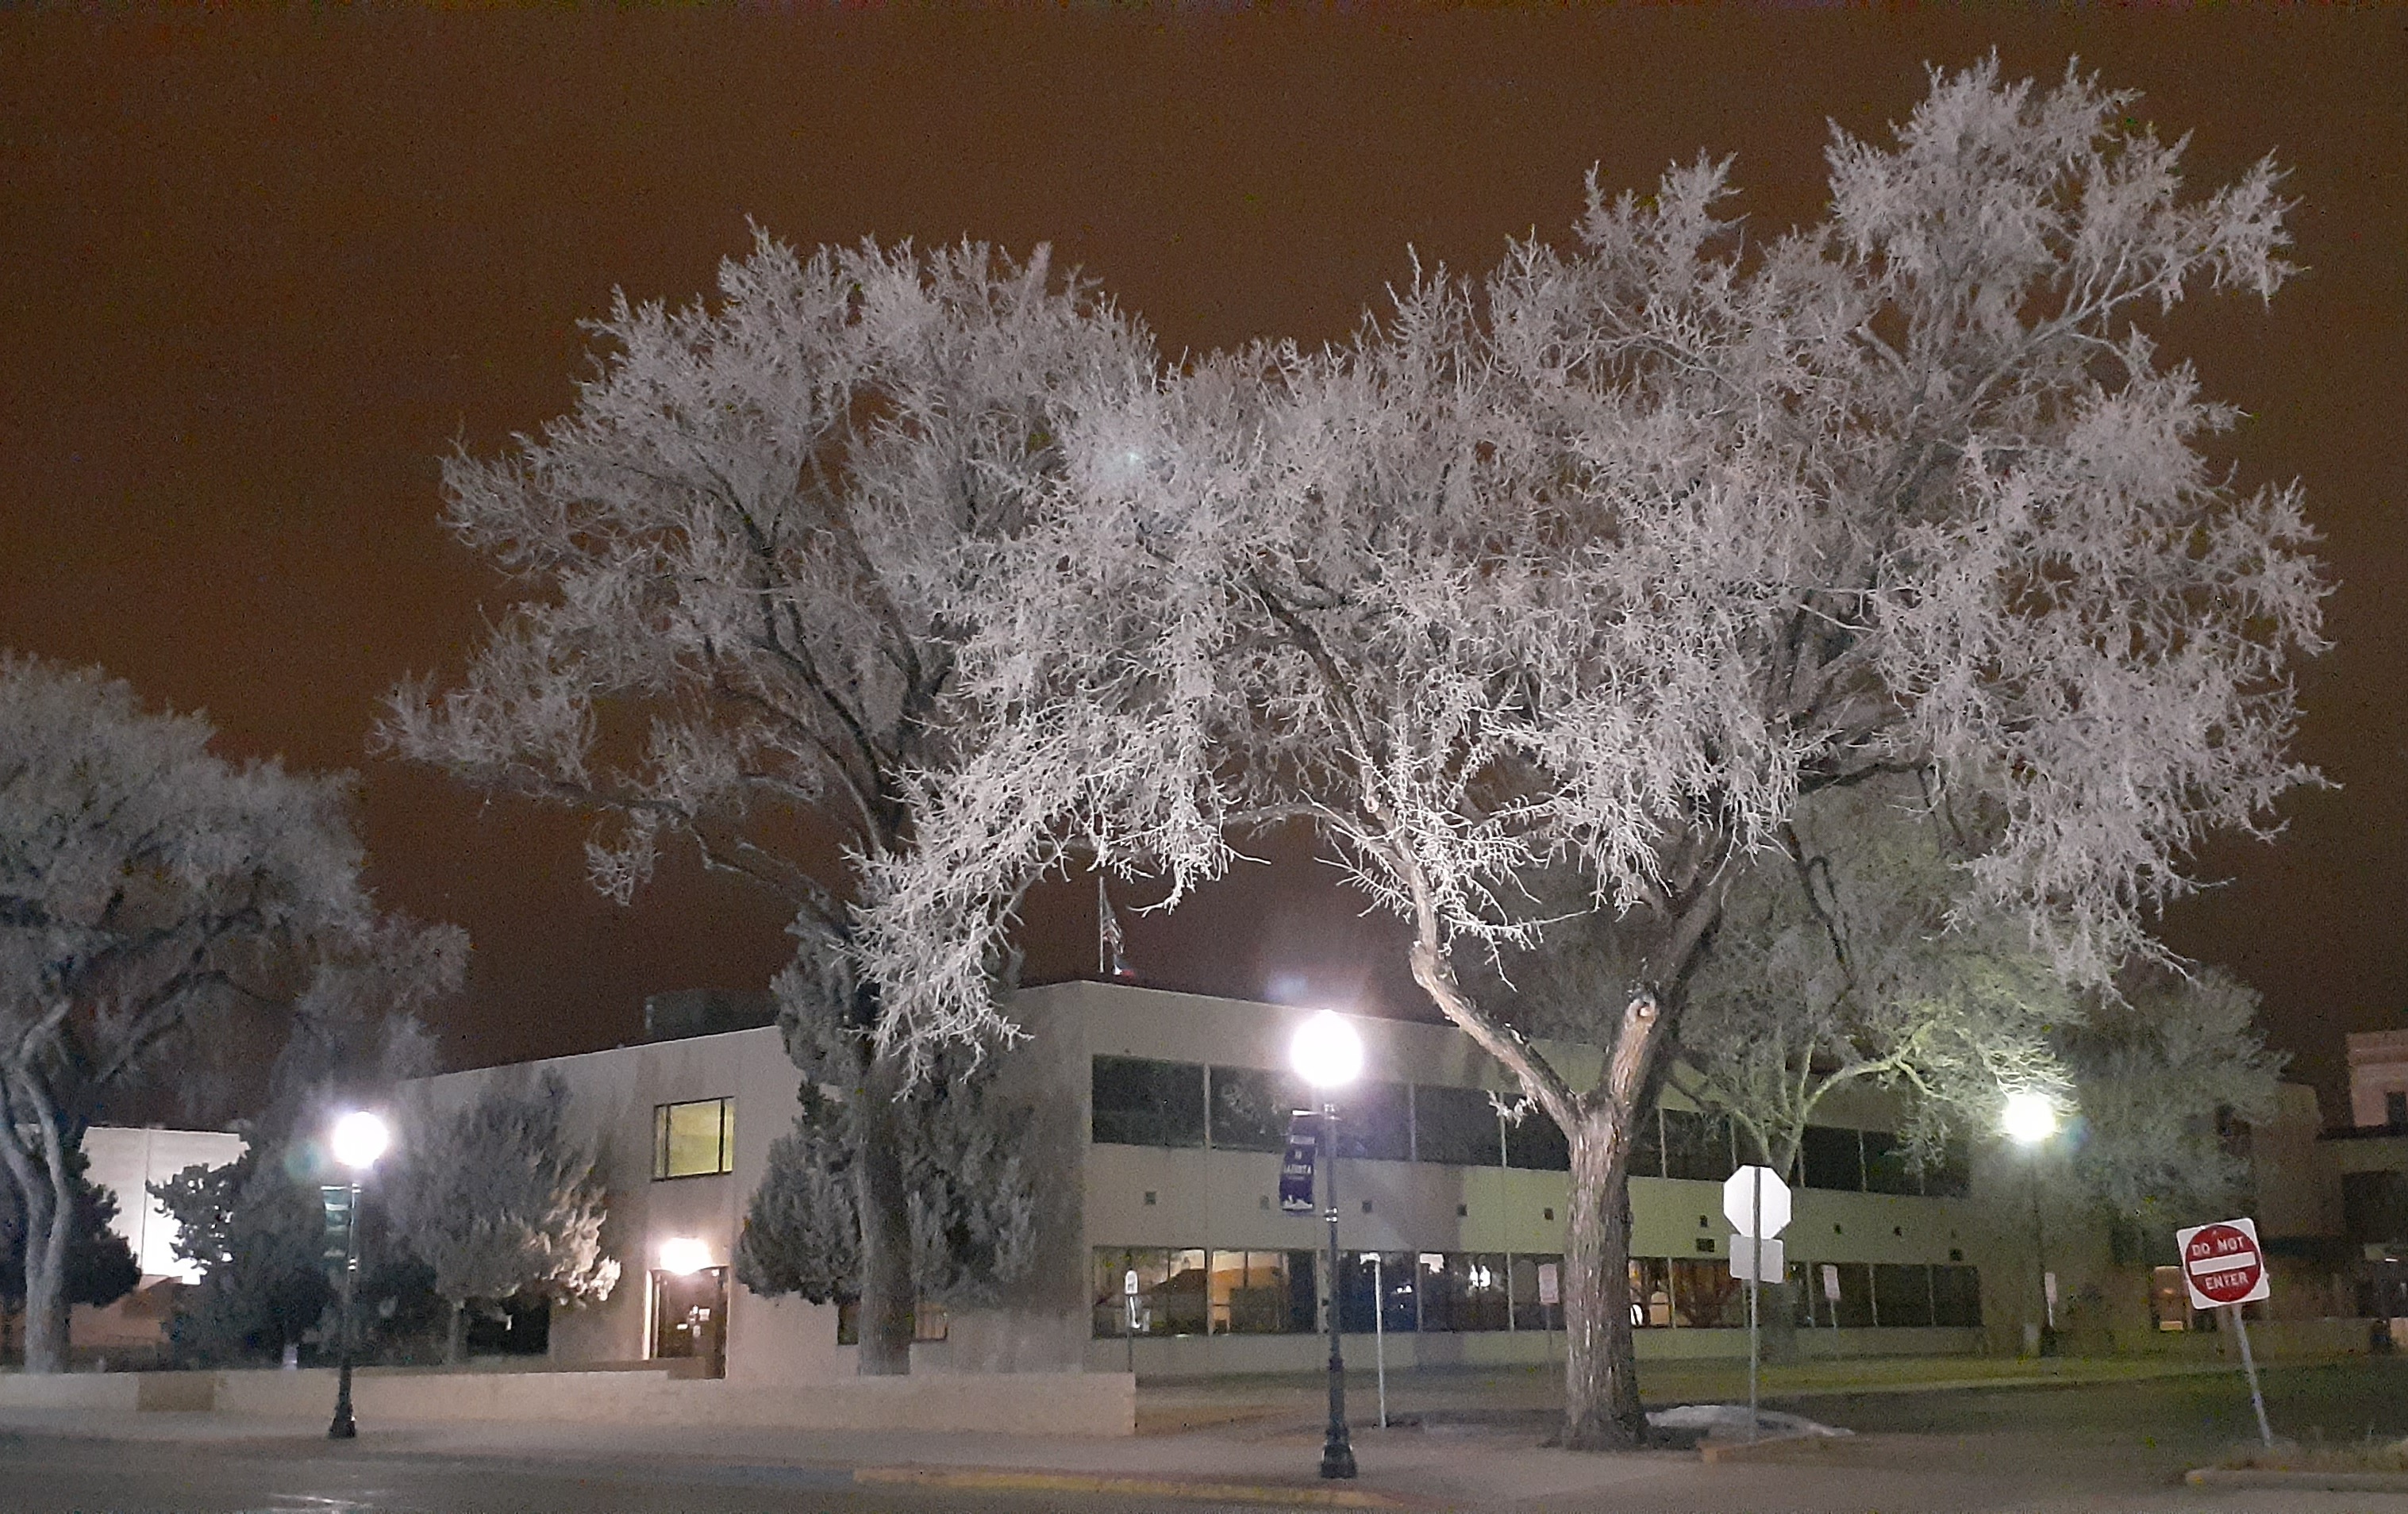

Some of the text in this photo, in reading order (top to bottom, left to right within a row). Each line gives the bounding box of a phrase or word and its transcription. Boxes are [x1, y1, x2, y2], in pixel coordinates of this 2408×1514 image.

[2191, 1236, 2244, 1256] DO NOT
[2205, 1271, 2248, 1290] ENTER
